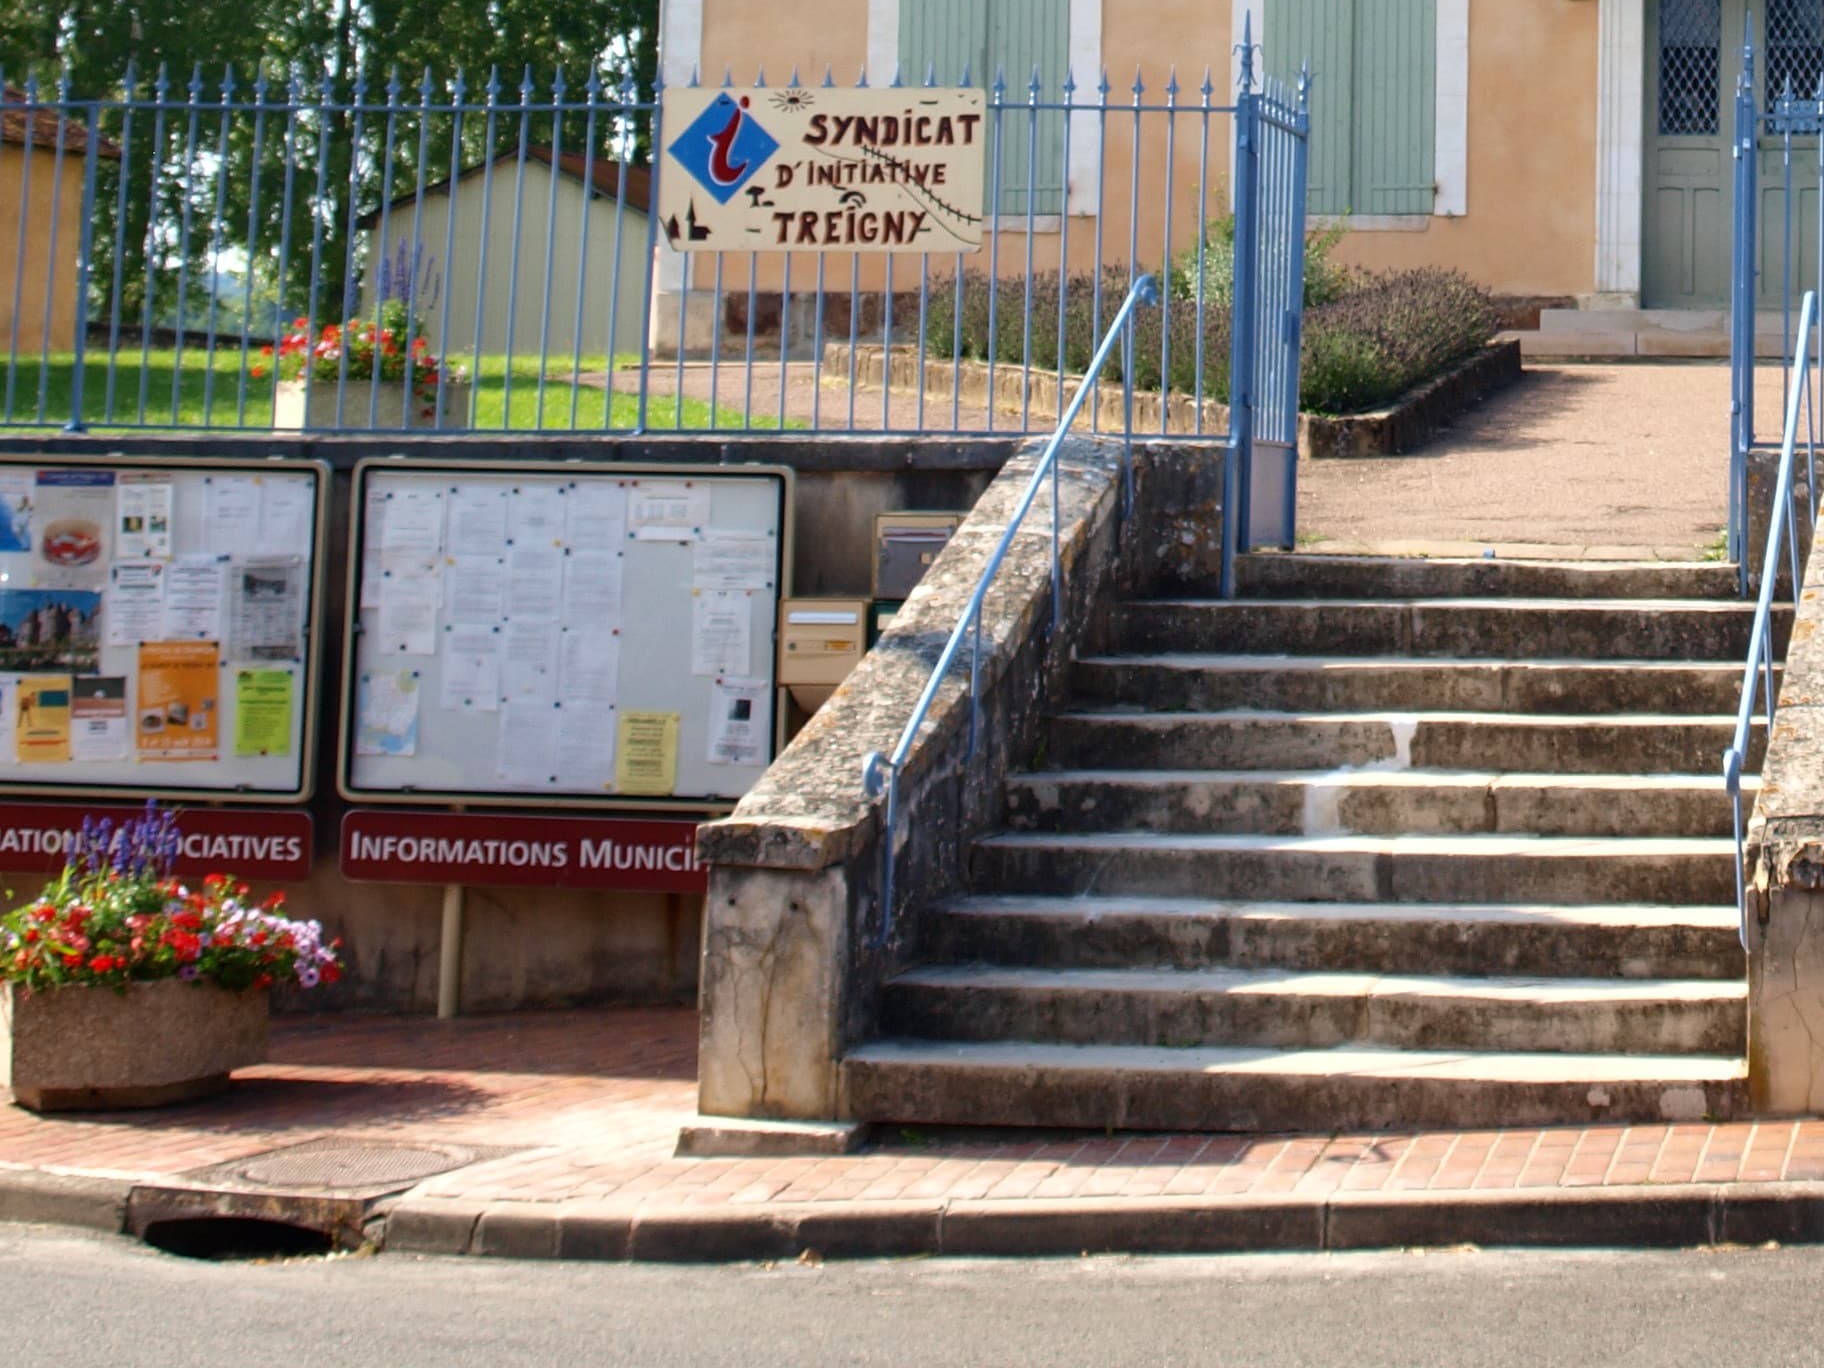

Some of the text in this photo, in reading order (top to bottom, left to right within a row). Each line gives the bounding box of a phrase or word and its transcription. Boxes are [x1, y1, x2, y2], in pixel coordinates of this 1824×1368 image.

[802, 108, 981, 147] SYNDICAT
[772, 206, 927, 245] TREIGNY
[350, 829, 701, 872] INFORMATIONS MUNICI
